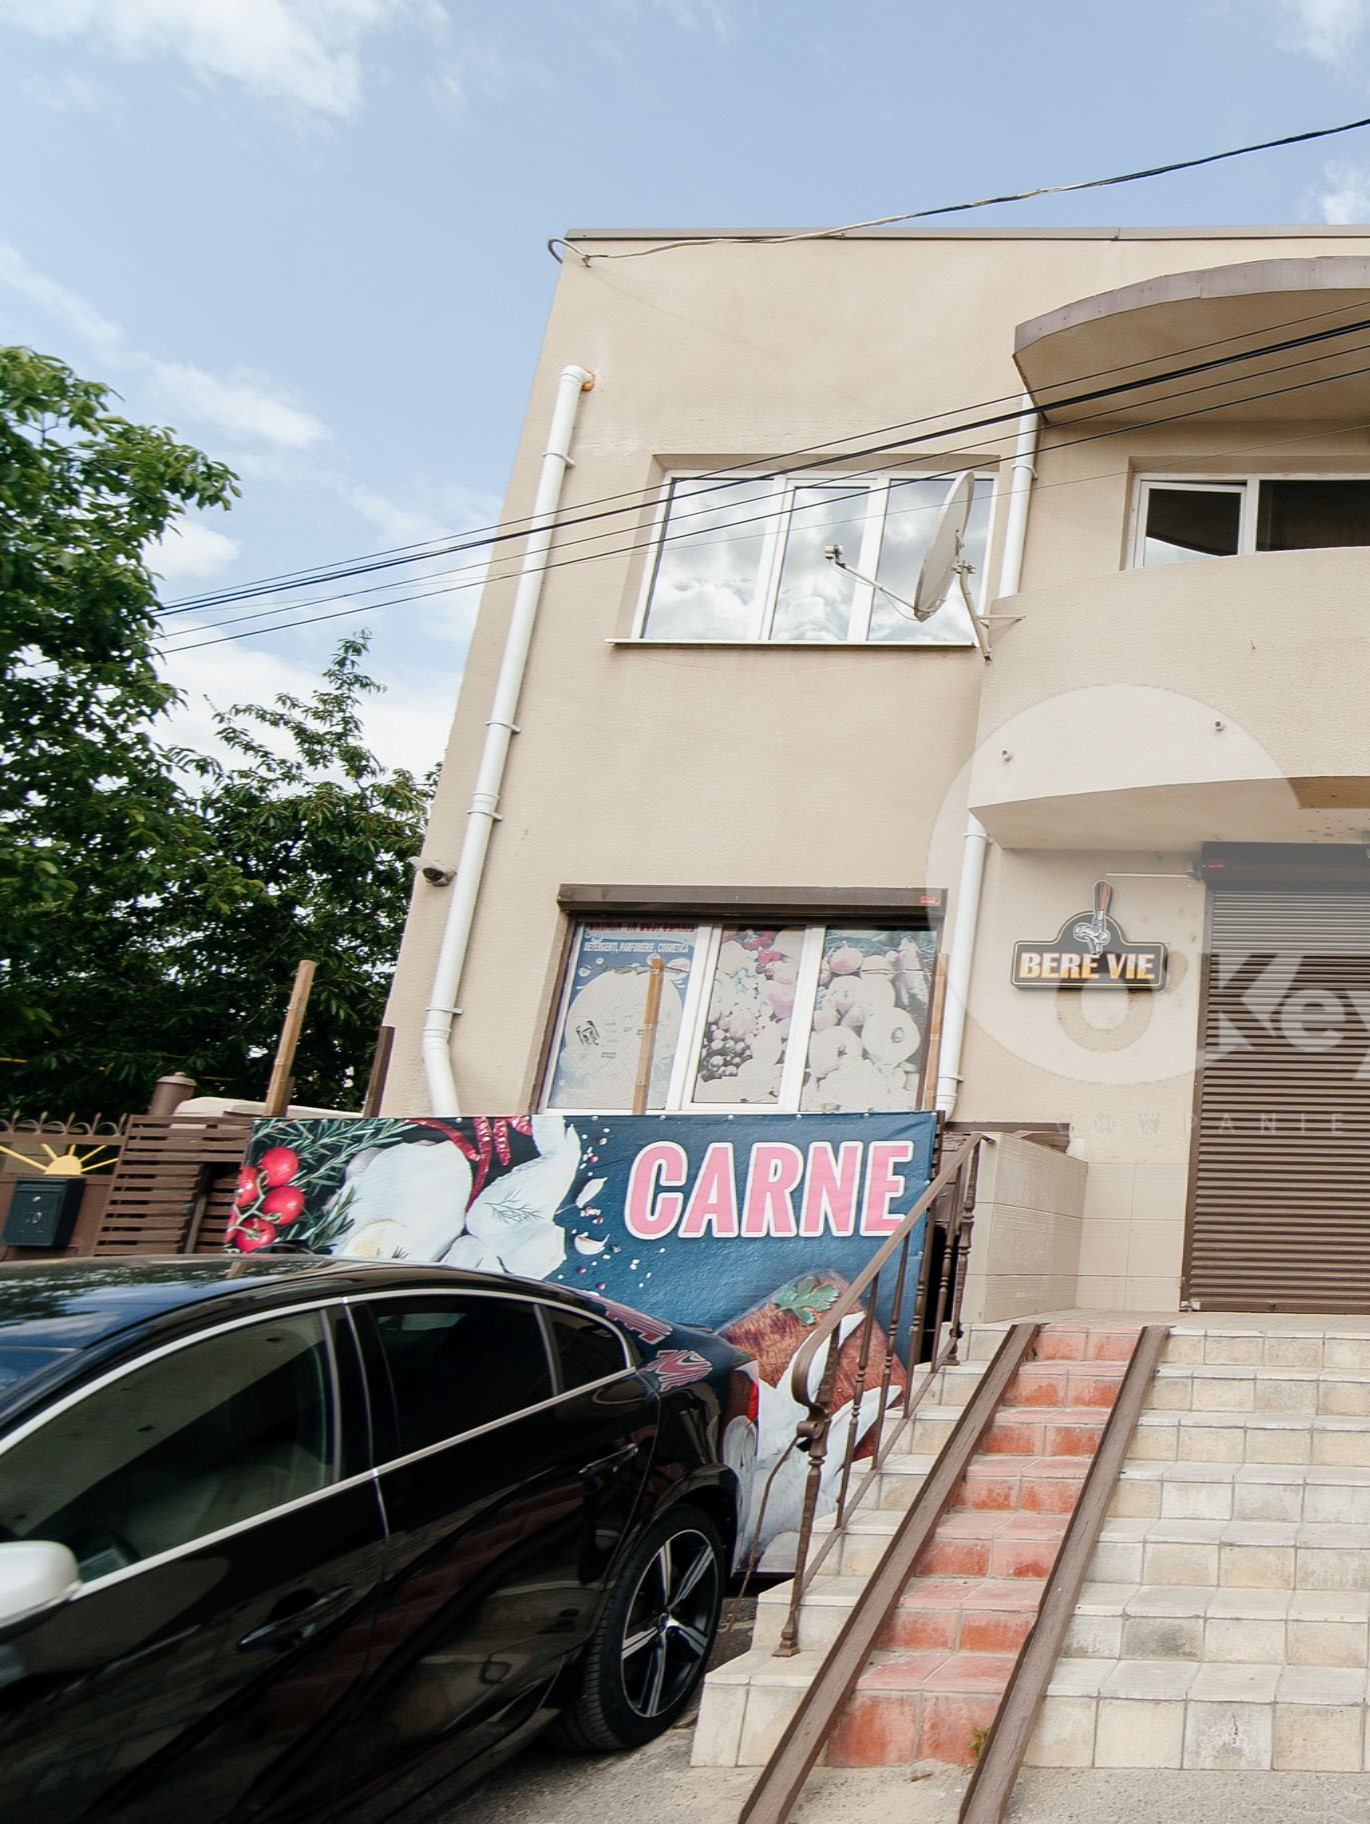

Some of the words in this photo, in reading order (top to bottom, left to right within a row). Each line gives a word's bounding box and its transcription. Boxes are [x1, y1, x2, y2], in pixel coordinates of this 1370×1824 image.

[1018, 951, 1101, 979] BERE
[1106, 952, 1156, 980] VIE
[624, 1140, 915, 1241] CARNE
